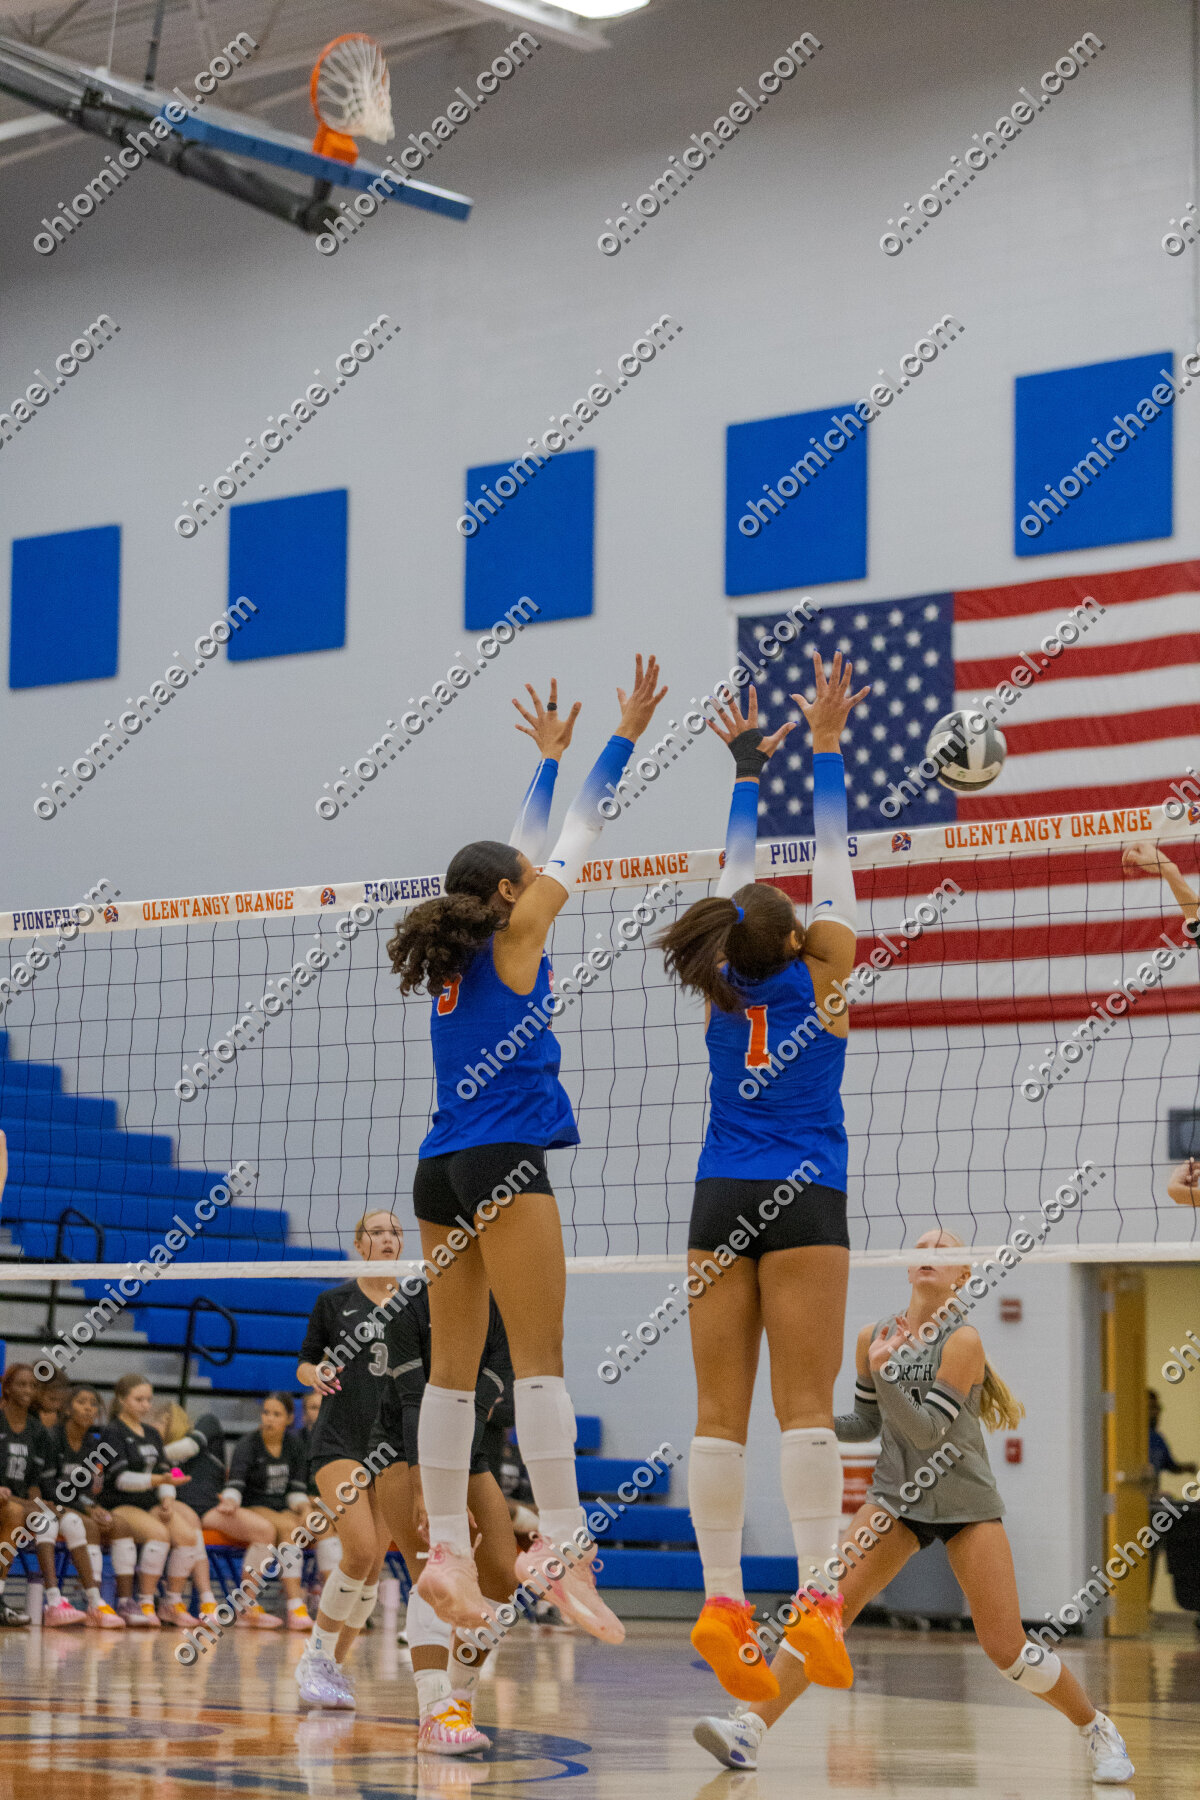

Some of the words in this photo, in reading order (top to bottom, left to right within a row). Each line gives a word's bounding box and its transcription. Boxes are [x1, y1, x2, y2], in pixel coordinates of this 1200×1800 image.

[944, 817, 1063, 849] OLENTANGY
[1071, 808, 1152, 838] ORANGE
[770, 836, 858, 865] PIONS
[620, 853, 689, 879] ORANGE
[364, 876, 441, 903] PIONEERS
[142, 895, 230, 921] OLENTANGY
[235, 890, 294, 913] ORANGE
[745, 1004, 772, 1069] 1
[368, 1342, 389, 1377] 3
[886, 1363, 934, 1381] RTH
